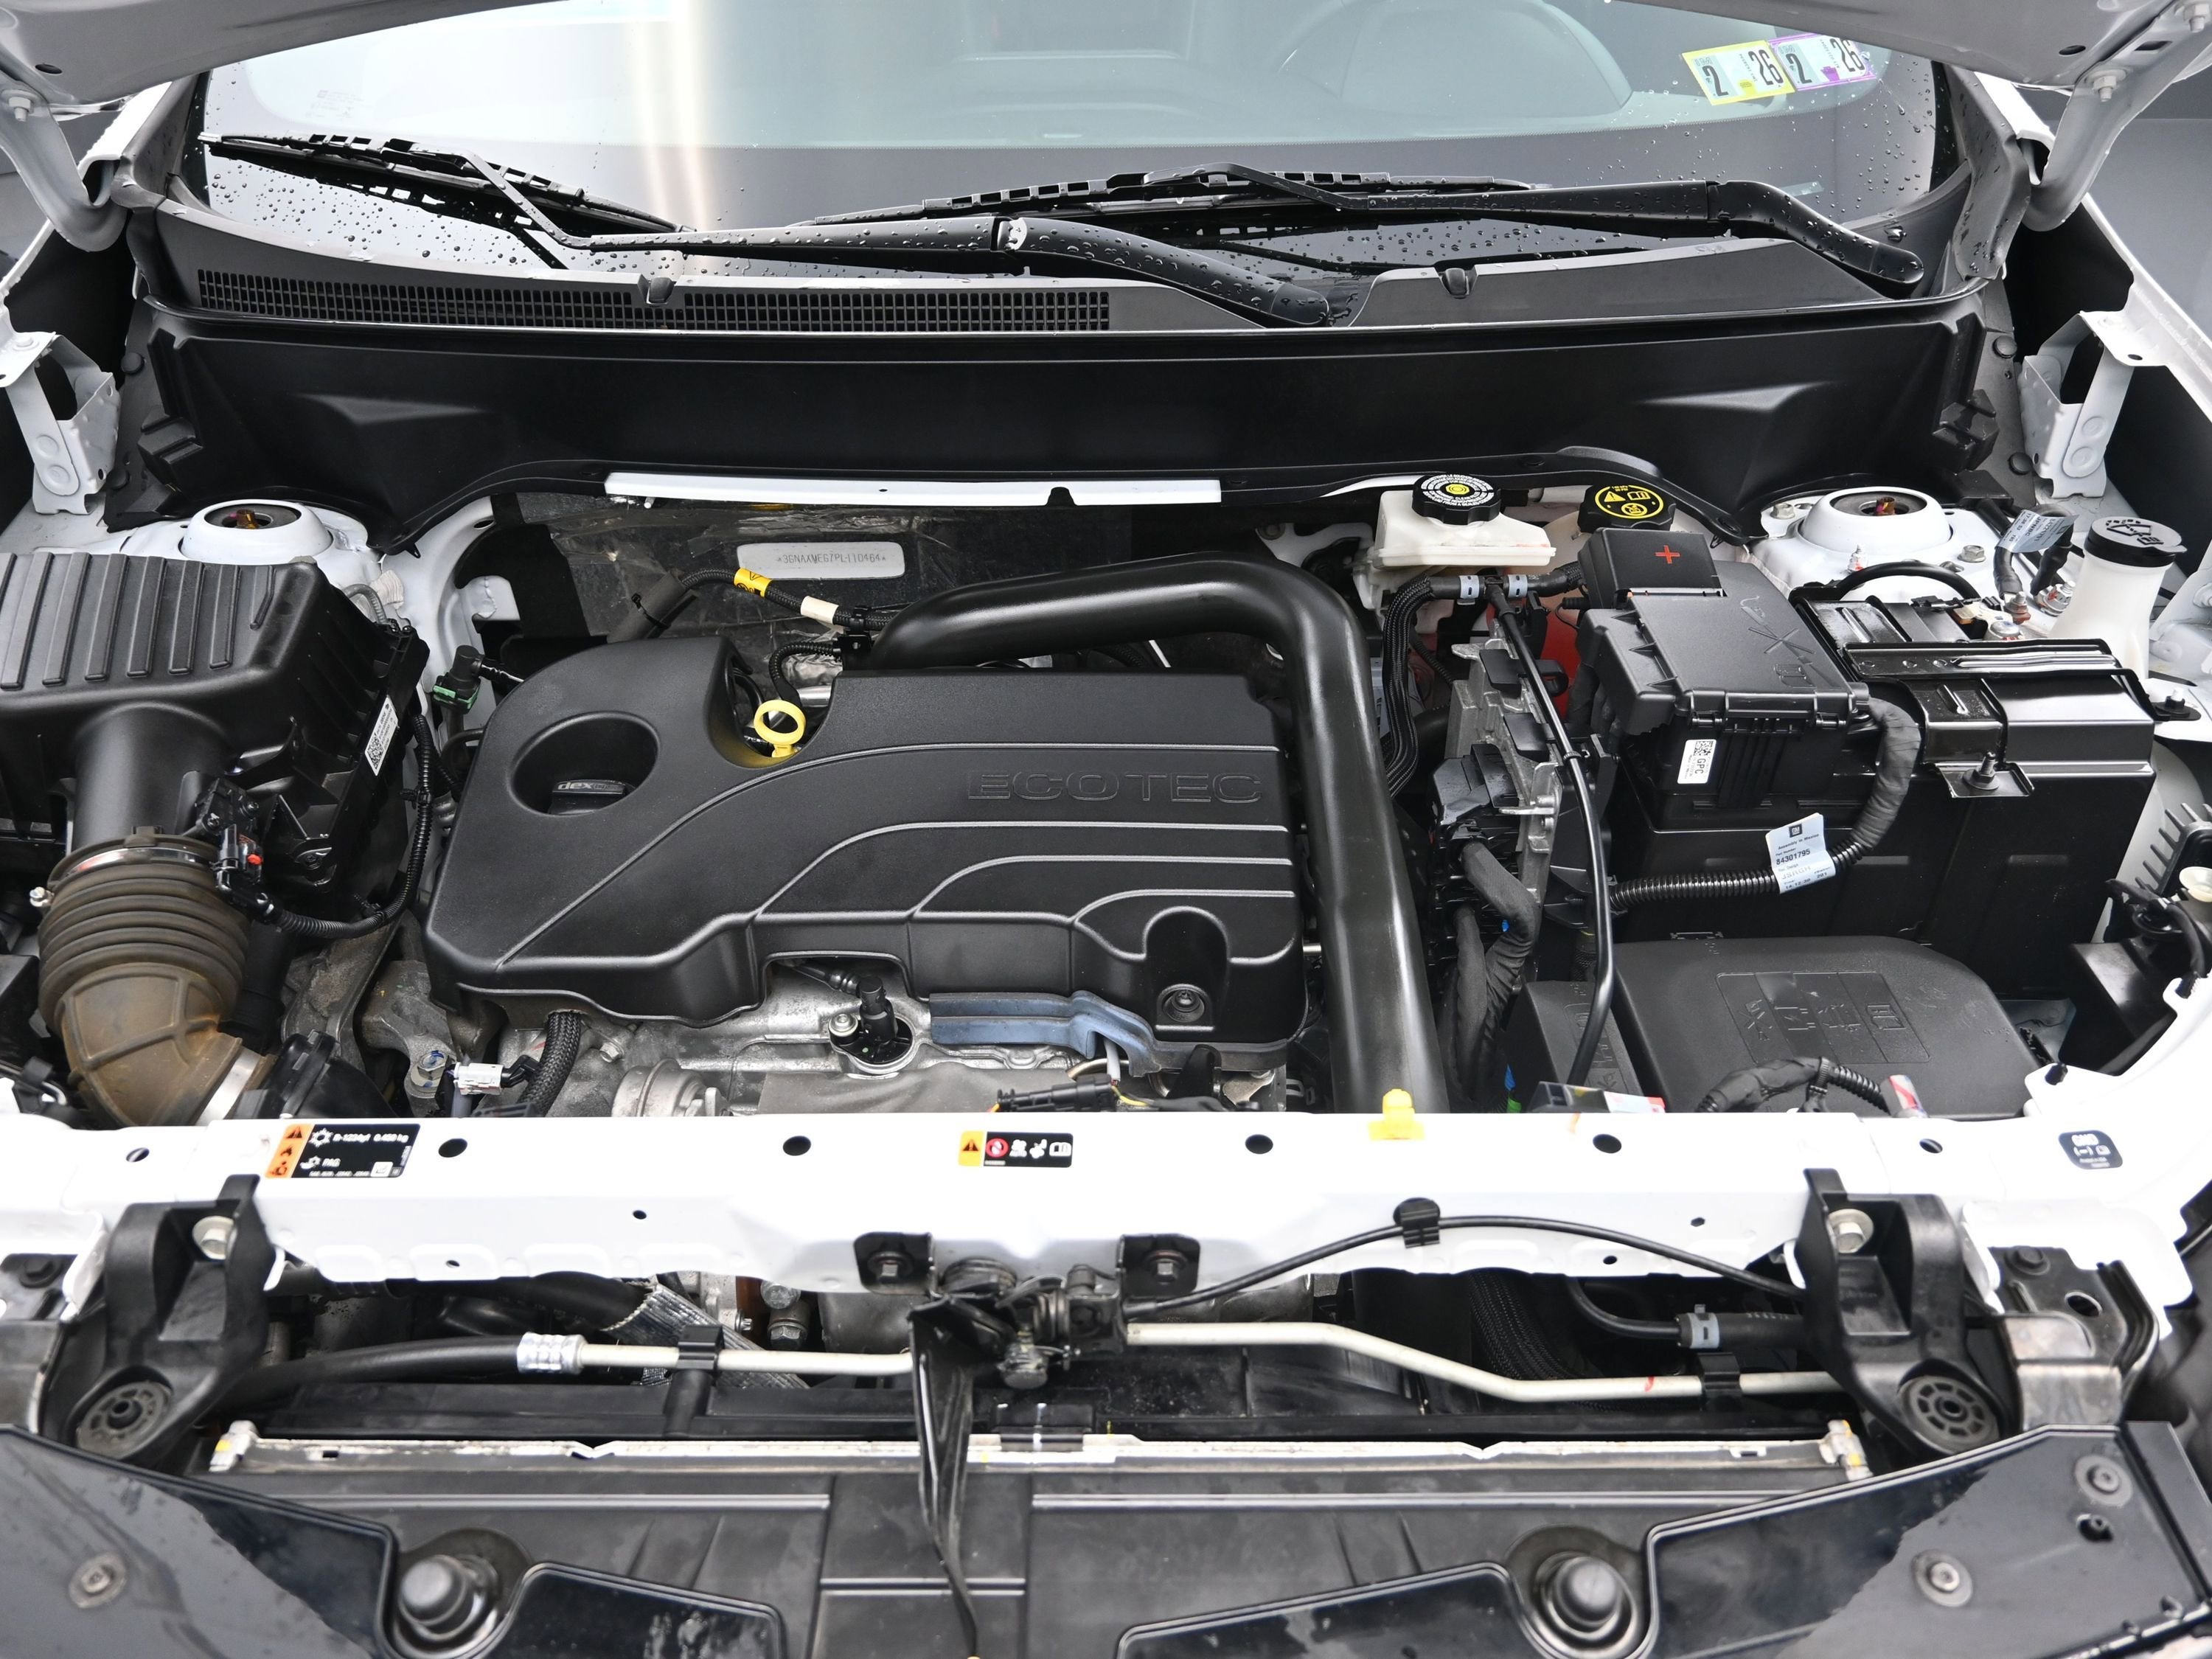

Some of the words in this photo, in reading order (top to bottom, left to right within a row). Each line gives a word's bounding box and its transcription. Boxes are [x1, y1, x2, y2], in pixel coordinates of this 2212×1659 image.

[1748, 49, 1784, 86] 26
[1786, 53, 1812, 84] 2
[1829, 38, 1865, 72] 26
[1702, 65, 1729, 97] 2
[1694, 758, 1706, 774] GPC
[968, 771, 1262, 804] ECOTEC
[1776, 849, 1810, 865] 84301795
